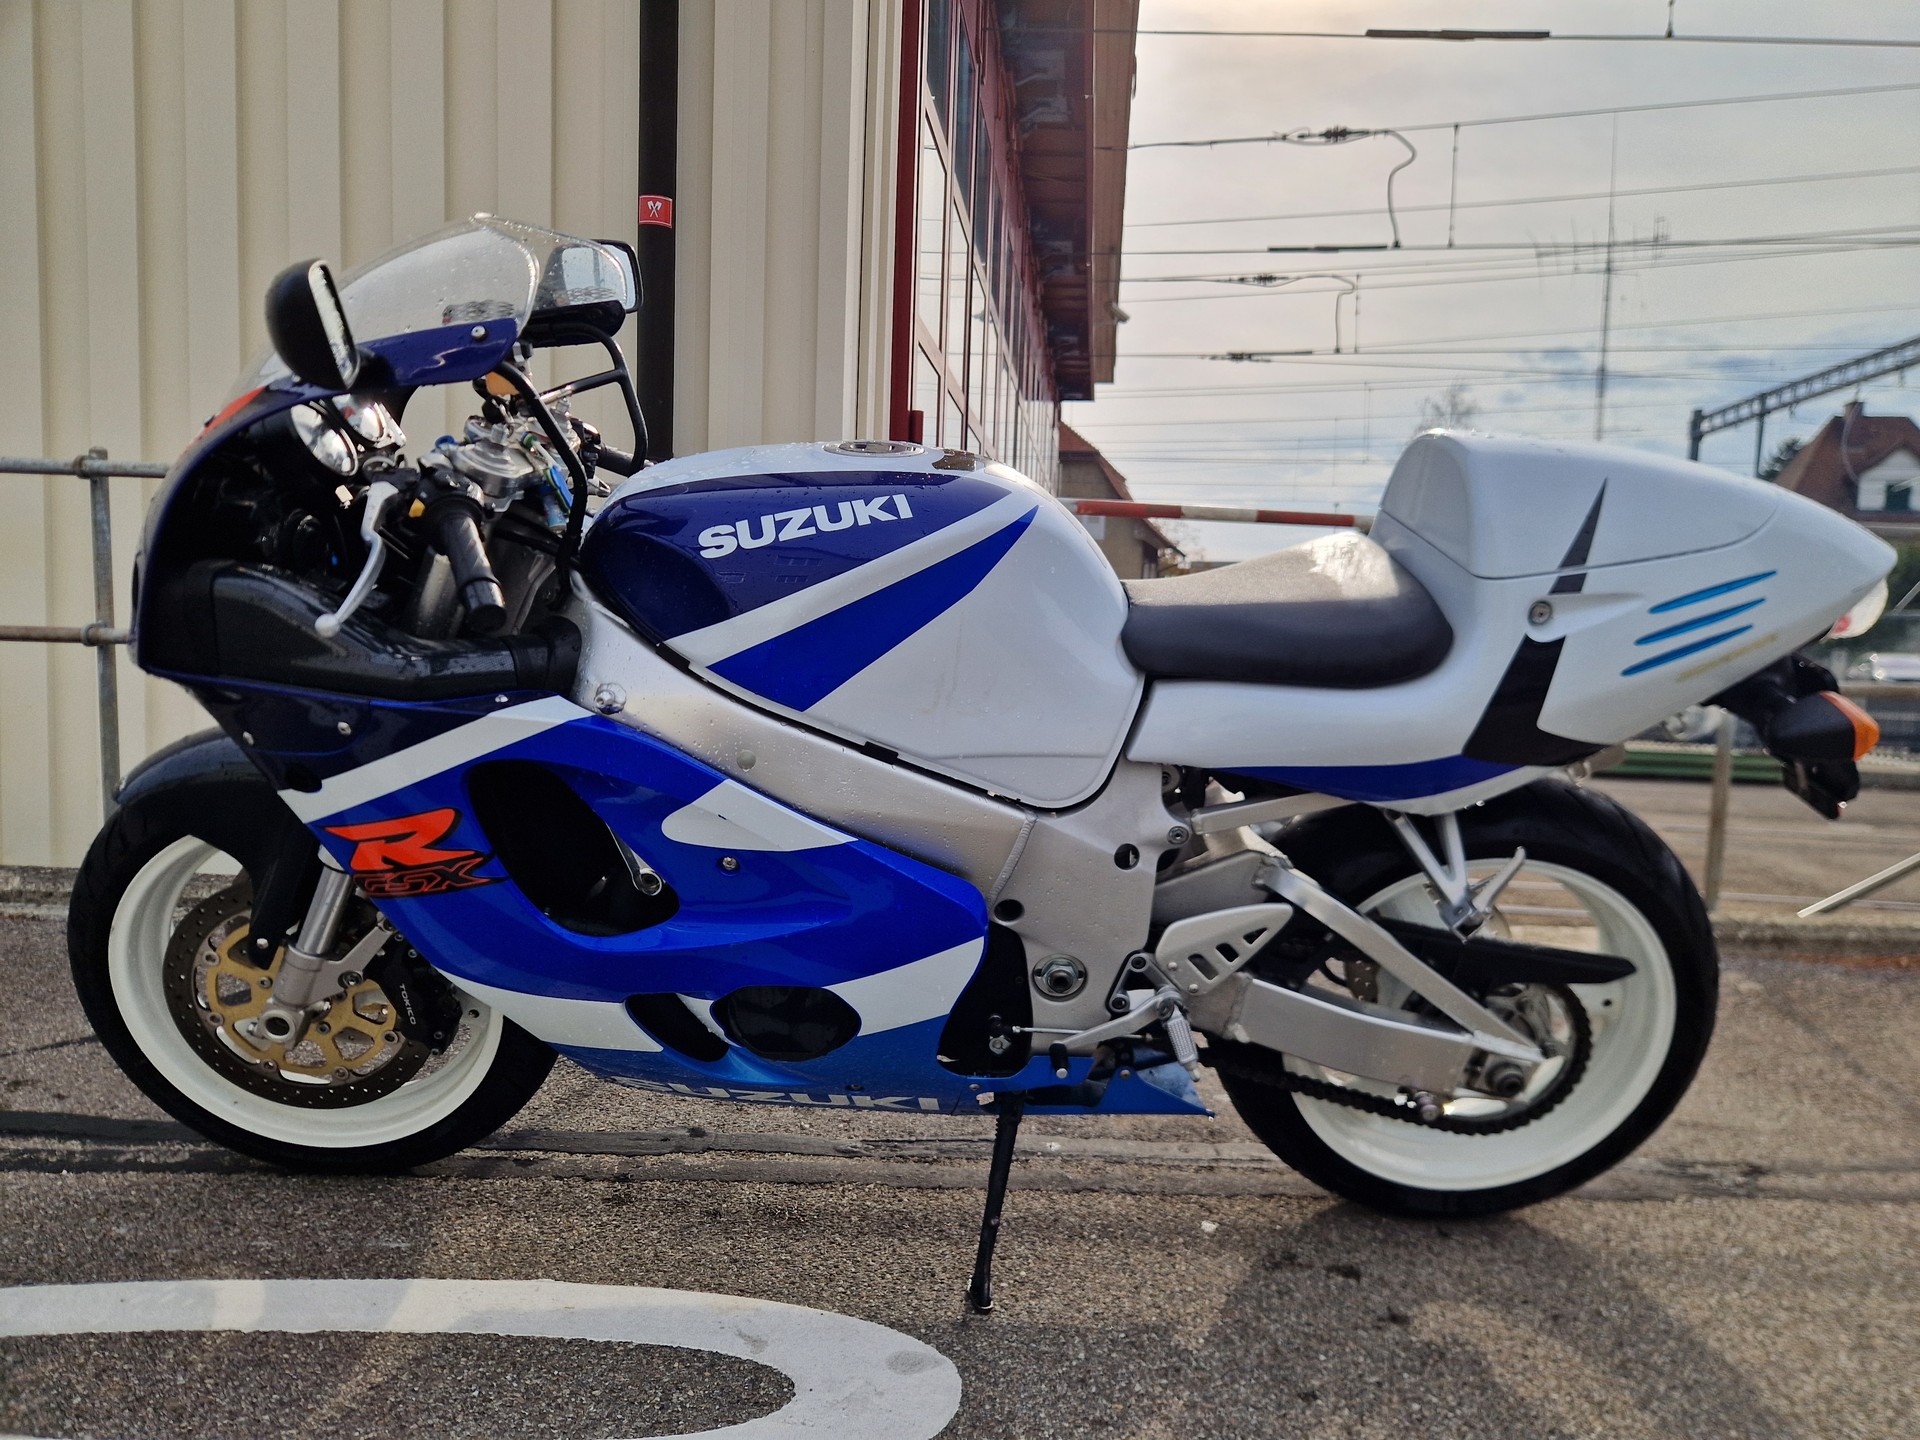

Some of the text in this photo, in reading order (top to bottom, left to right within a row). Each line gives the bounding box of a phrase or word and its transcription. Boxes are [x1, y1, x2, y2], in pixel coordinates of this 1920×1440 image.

[698, 493, 914, 559] SUZUKI
[325, 808, 476, 872] R
[353, 857, 493, 897] GSX
[399, 983, 417, 1025] TOKICO
